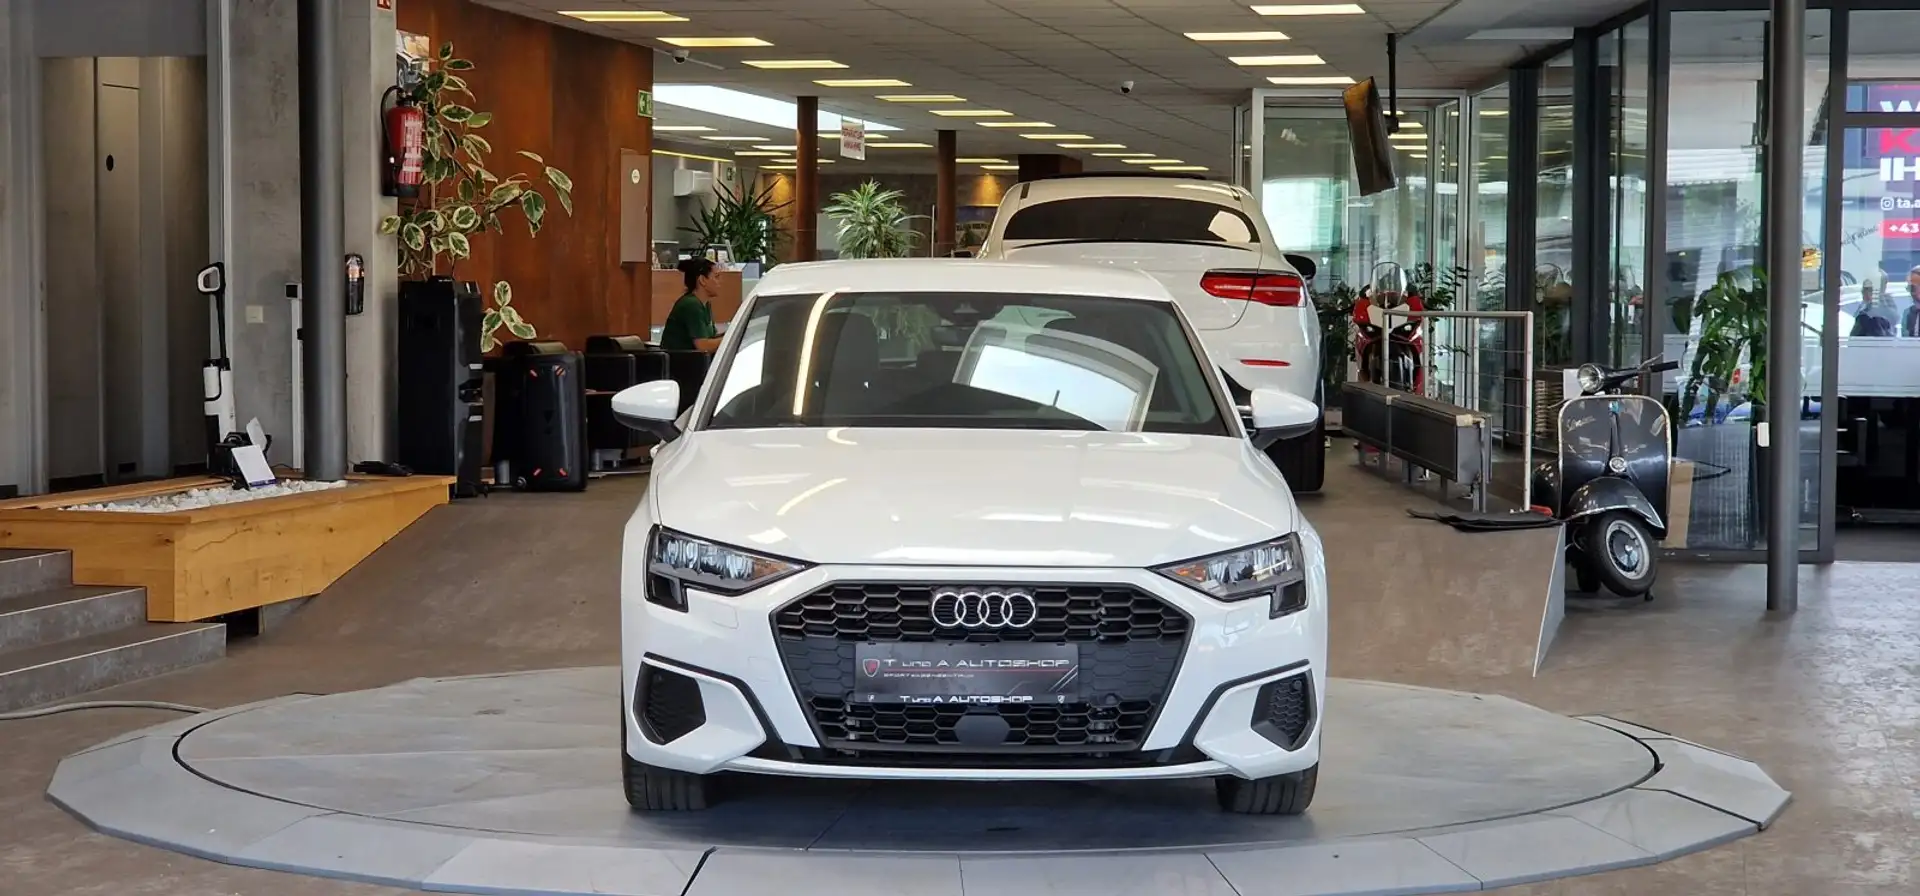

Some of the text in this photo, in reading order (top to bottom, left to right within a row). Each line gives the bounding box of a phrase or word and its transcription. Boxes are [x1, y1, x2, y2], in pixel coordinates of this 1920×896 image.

[1889, 222, 1920, 233] +43
[883, 659, 897, 667] T
[937, 659, 950, 667] A
[956, 659, 1070, 667] AUTOSHOP
[899, 695, 911, 704] T
[932, 695, 945, 704] A
[948, 695, 1034, 704] AUTOSHOP
